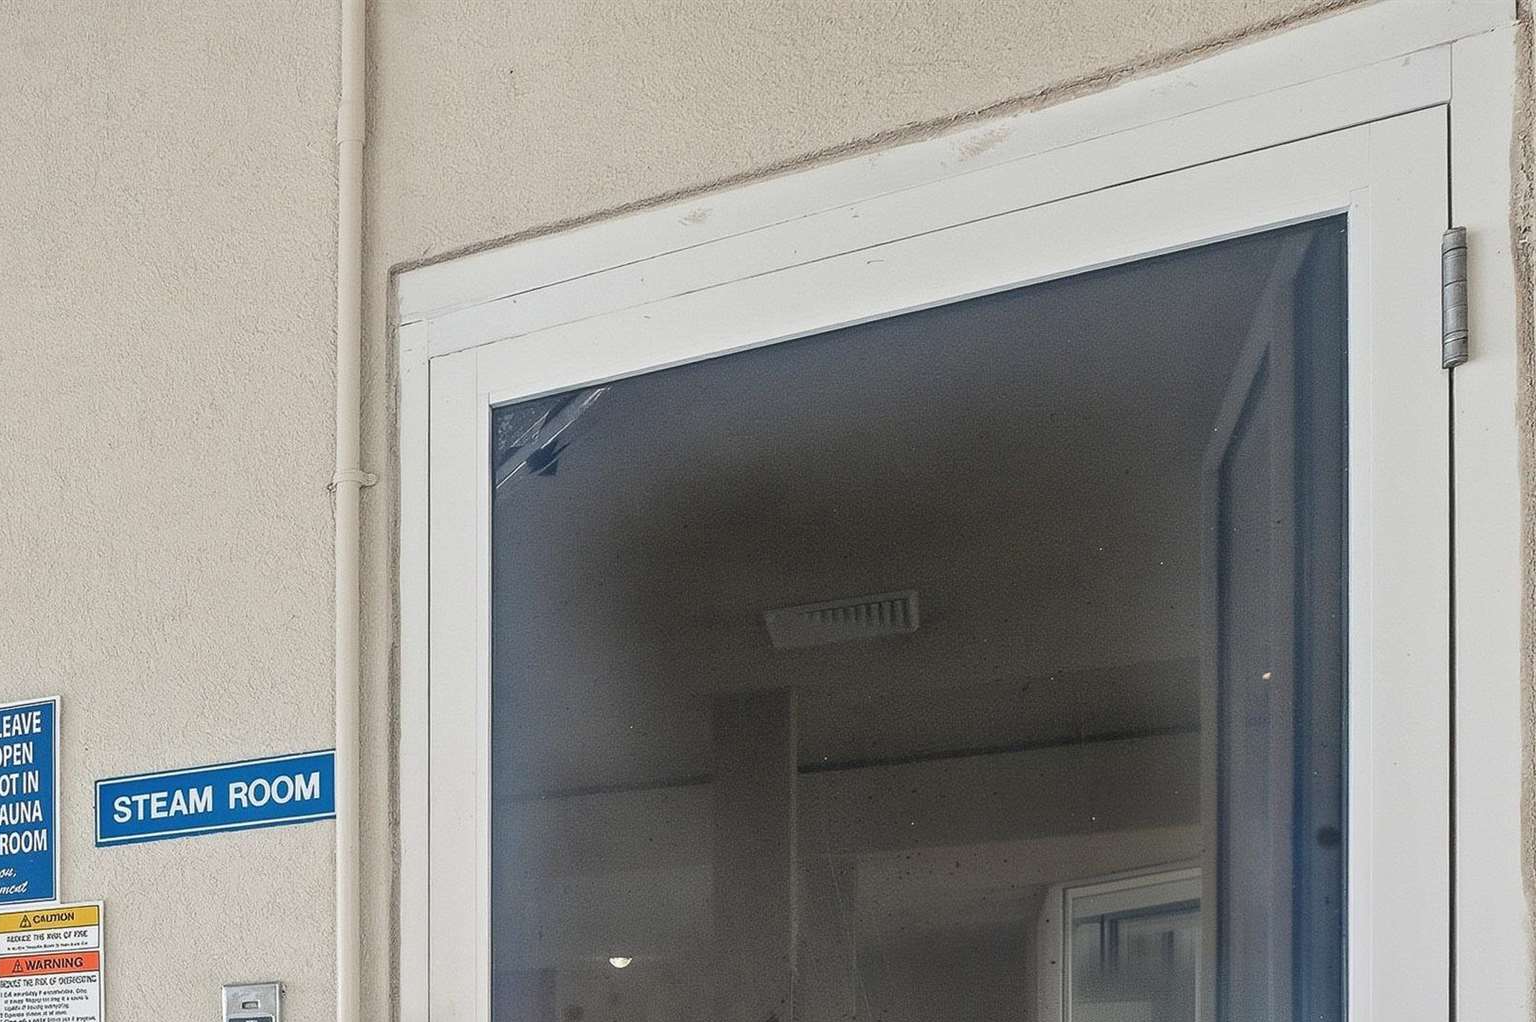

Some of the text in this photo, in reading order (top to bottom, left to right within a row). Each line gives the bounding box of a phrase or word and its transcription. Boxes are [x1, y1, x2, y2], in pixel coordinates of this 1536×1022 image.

[22, 770, 39, 794] IN
[114, 772, 320, 823] STEAM ROOM
[0, 829, 47, 855] ROOM
[32, 912, 75, 925] CAUTION
[26, 957, 84, 971] WARNING
